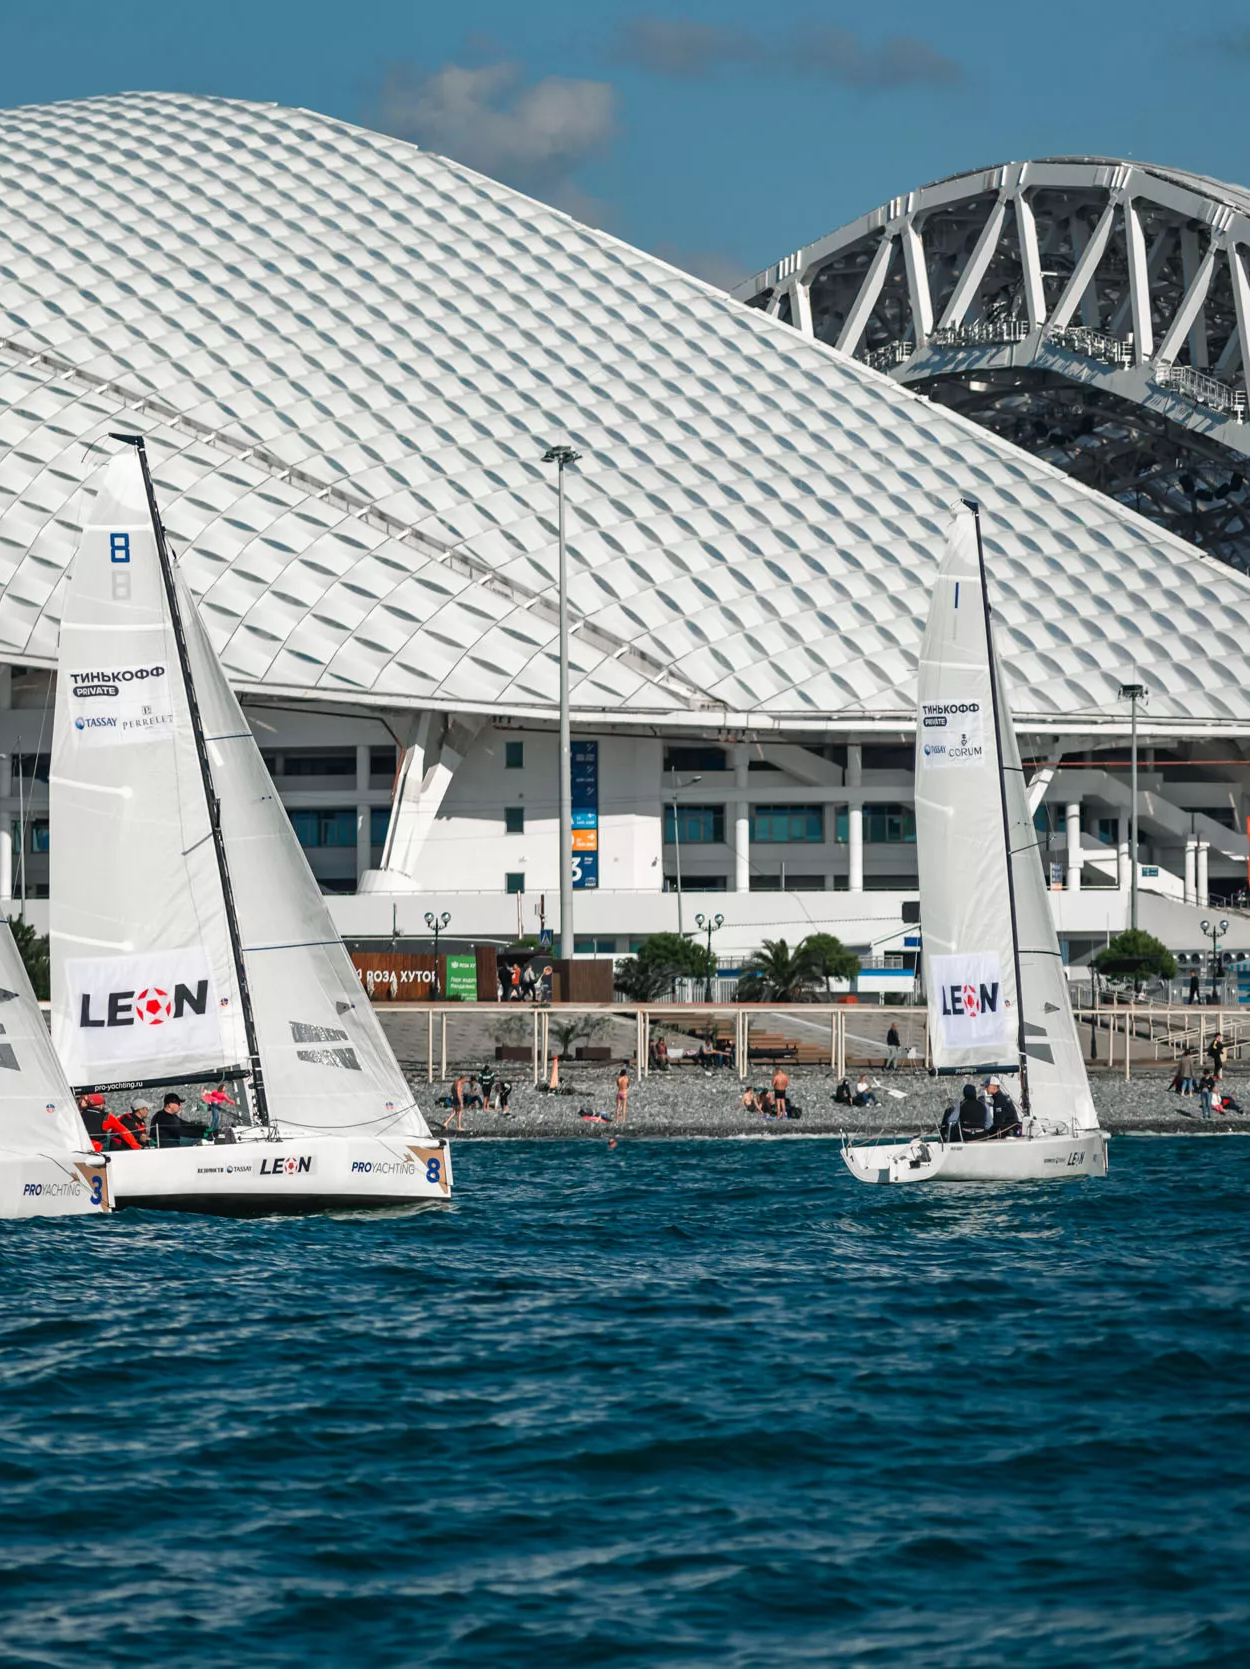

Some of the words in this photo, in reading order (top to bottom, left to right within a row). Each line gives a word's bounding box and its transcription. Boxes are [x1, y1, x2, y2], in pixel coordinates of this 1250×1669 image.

[110, 533, 130, 563] 8
[70, 666, 165, 684] ТИНЬКОФФ
[76, 687, 116, 696] PRIVATE
[922, 703, 979, 715] ТИНЬКОФФ
[85, 717, 118, 728] TASSAY
[122, 714, 173, 730] PERRELET
[925, 718, 947, 726] PRIVATE
[949, 746, 982, 758] CORUM
[80, 980, 208, 1028] LEON
[942, 982, 999, 1017] LEON
[94, 1081, 143, 1092] pro-yachting.ru
[260, 1156, 312, 1175] LEON
[426, 1157, 440, 1183] 8
[90, 1175, 102, 1205] 3
